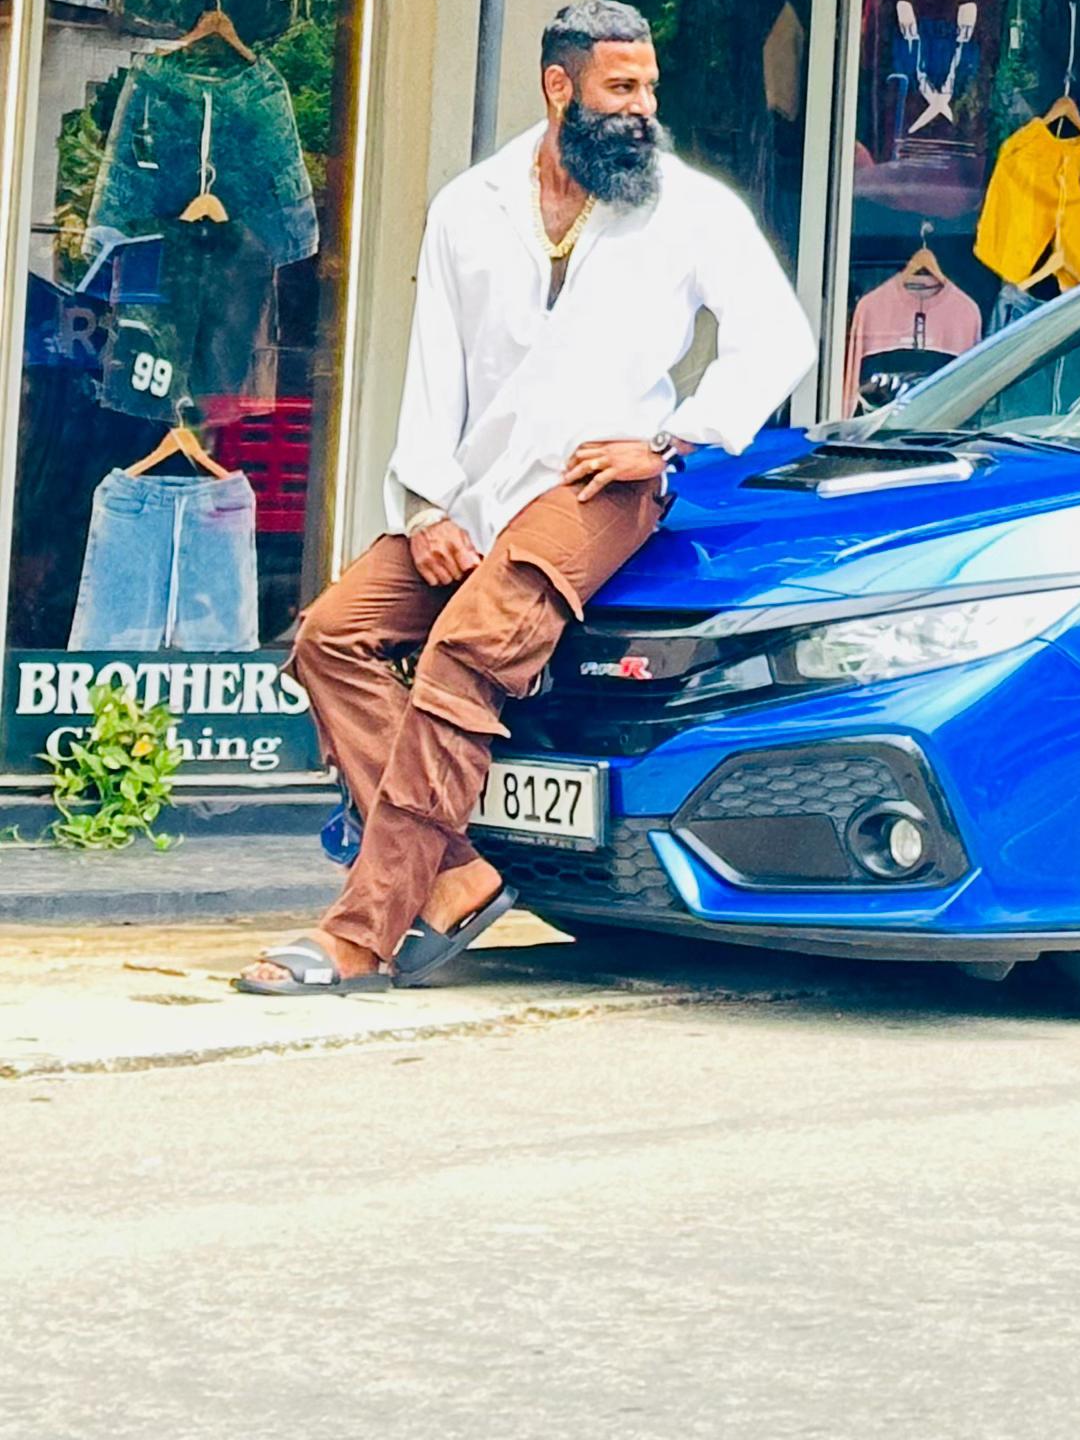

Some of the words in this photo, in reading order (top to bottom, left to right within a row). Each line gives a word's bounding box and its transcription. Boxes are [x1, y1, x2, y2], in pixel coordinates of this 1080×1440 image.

[131, 352, 173, 398] 99
[16, 662, 311, 715] BROTHERS
[46, 727, 282, 770] Ching
[503, 772, 582, 826] 8127
